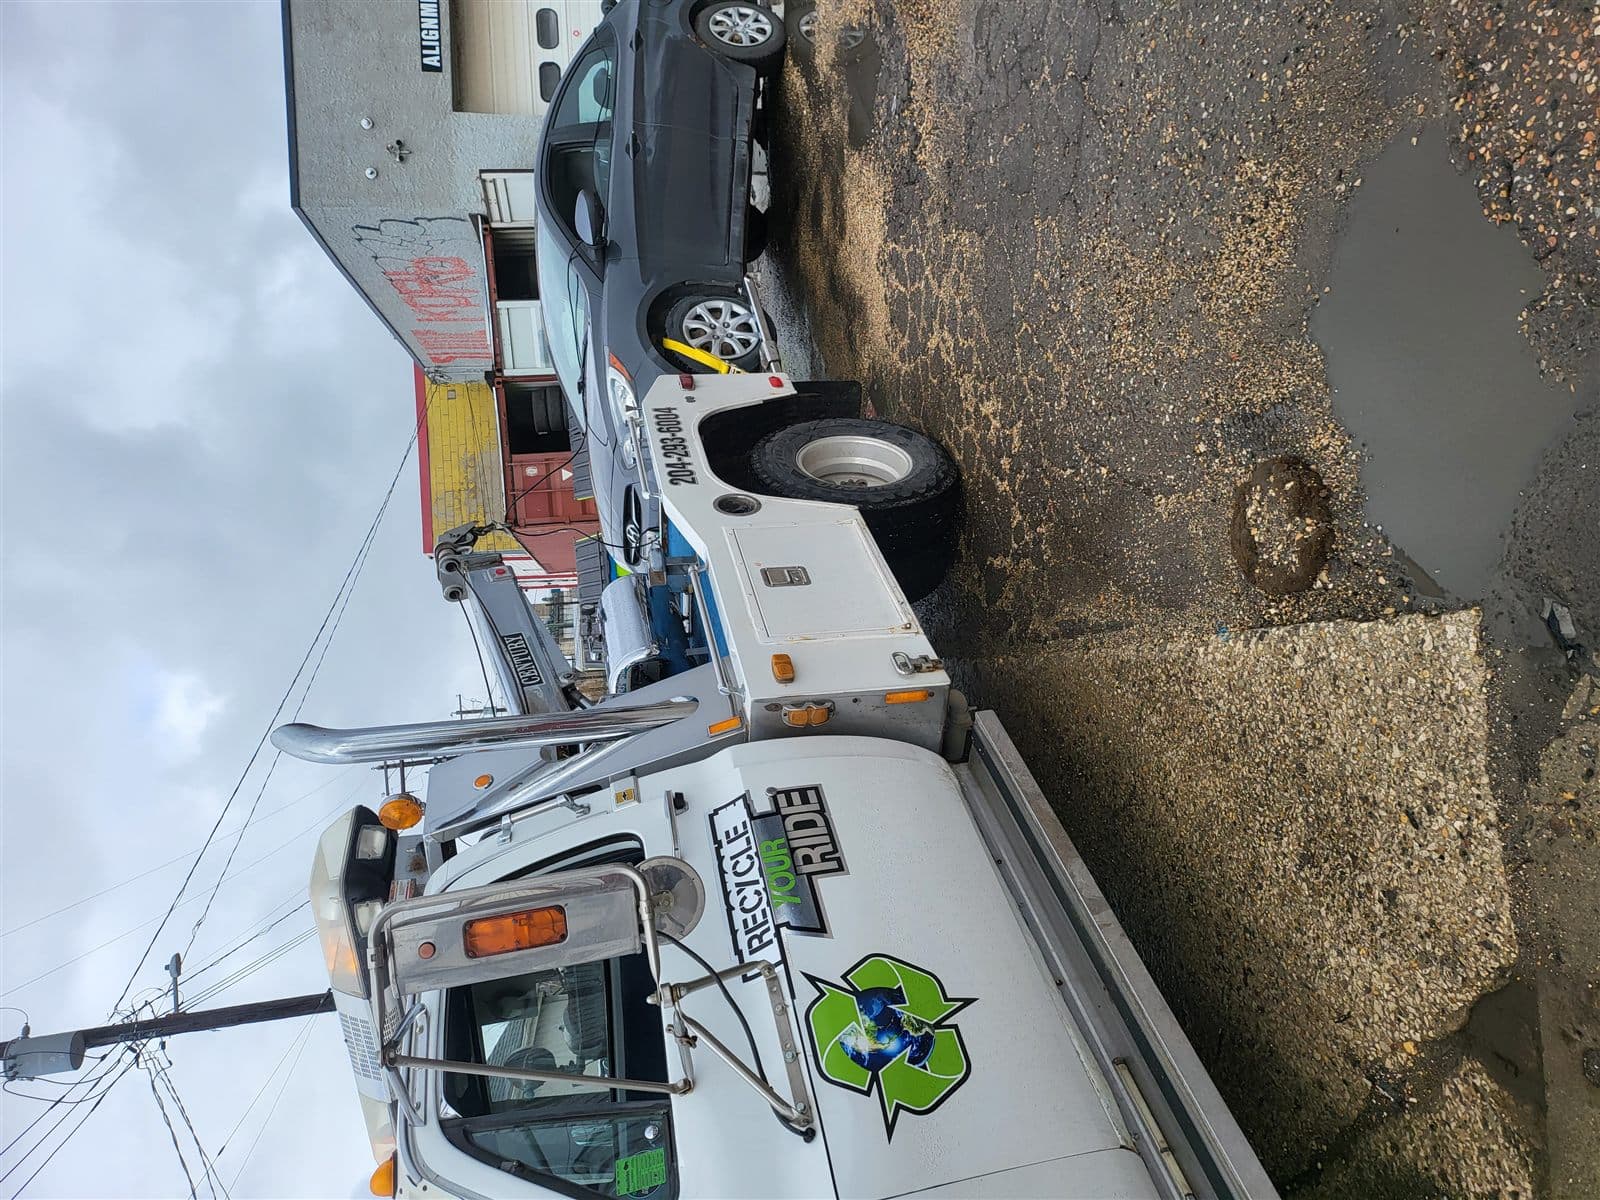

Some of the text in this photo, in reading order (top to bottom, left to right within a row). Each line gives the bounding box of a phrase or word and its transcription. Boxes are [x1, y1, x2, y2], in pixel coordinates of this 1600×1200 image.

[420, 0, 440, 68] ALIGNM
[652, 407, 698, 485] 204-293-6004
[503, 635, 540, 685] CENTURY
[776, 789, 839, 874] RIDE
[724, 820, 774, 956] RECYCLE
[759, 838, 802, 909] YOUR
